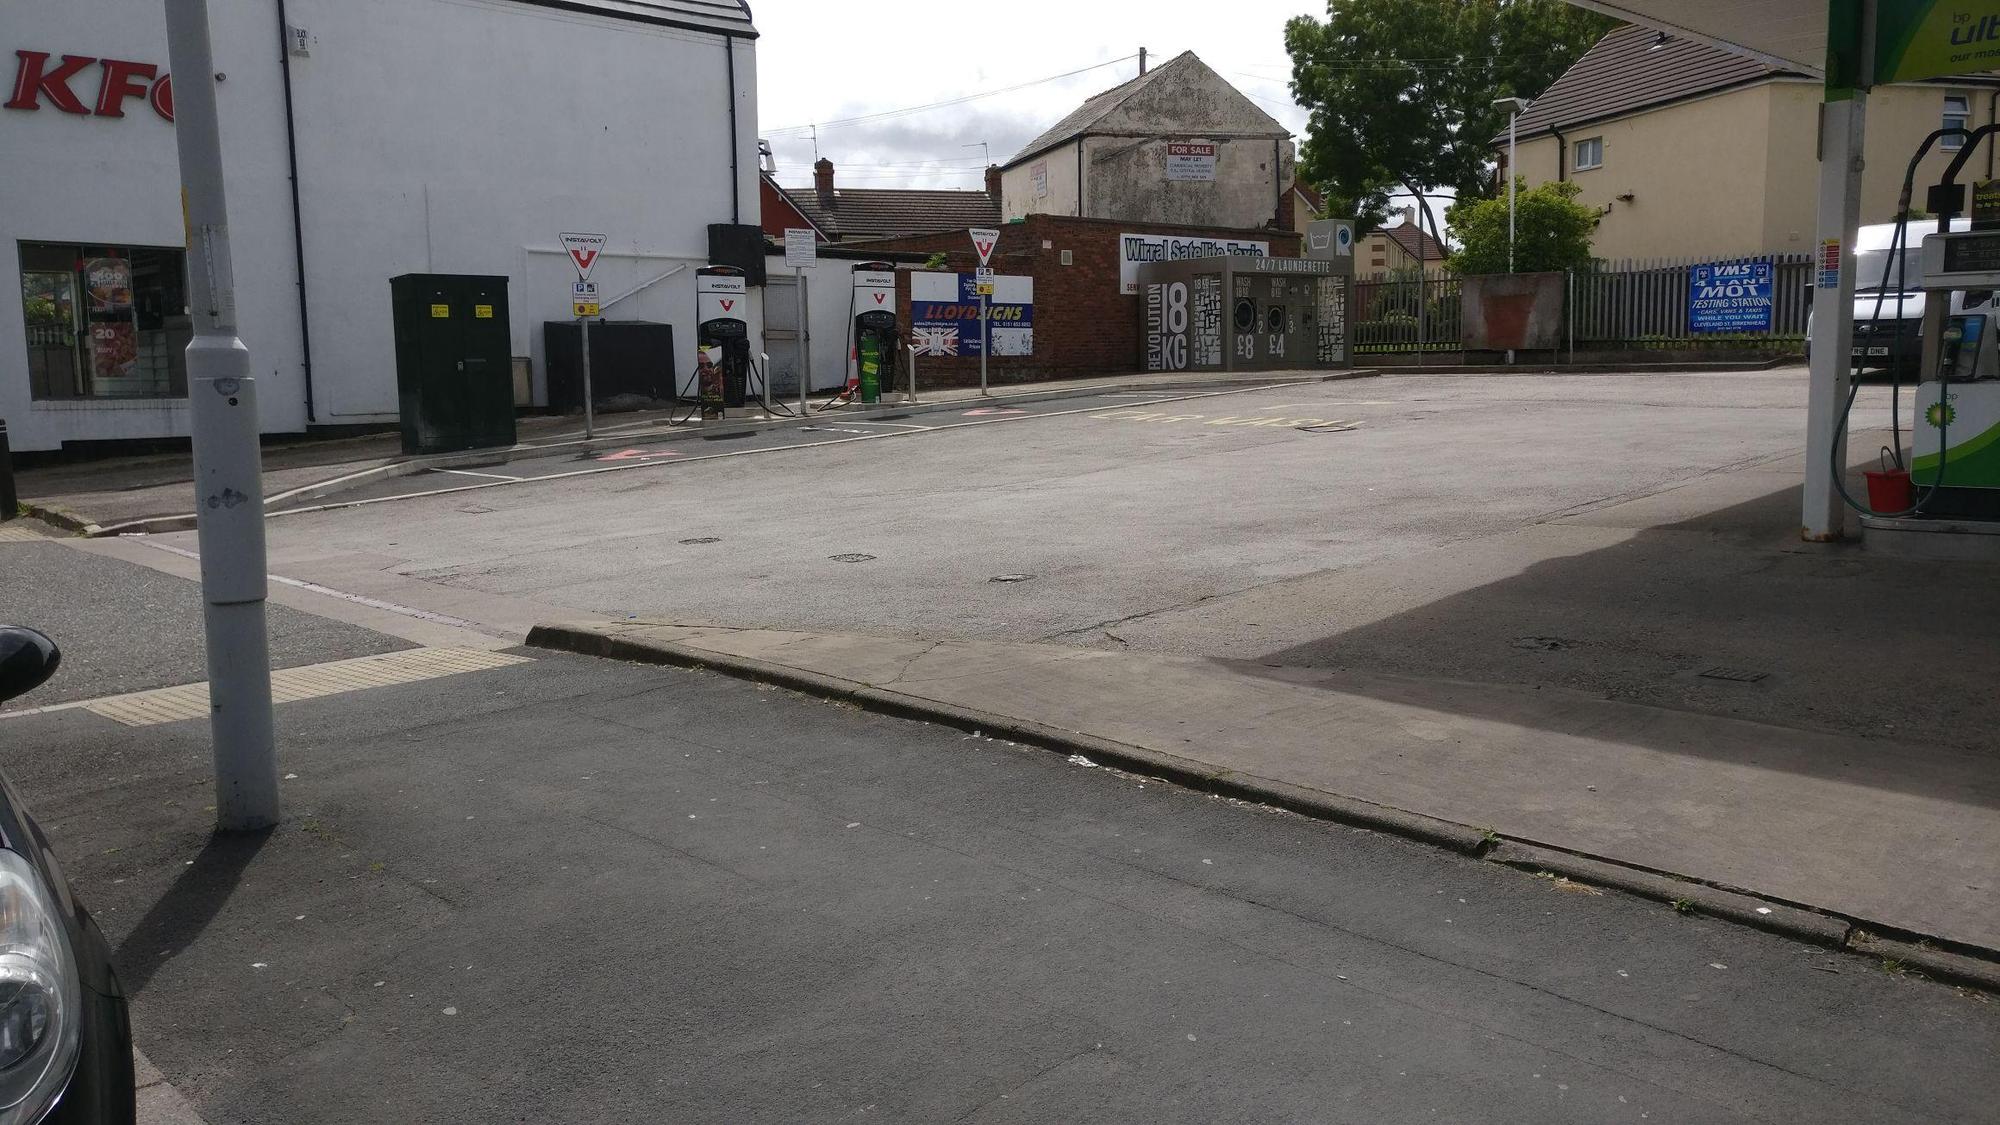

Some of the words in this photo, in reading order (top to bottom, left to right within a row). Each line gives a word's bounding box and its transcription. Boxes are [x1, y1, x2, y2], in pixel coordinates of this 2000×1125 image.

[1951, 53, 1971, 63] our
[1171, 146, 1188, 154] FOR
[1190, 146, 1211, 154] SALE
[1124, 237, 1168, 261] Wirral
[1171, 239, 1226, 260] Satellite
[1255, 259, 1276, 271] 24/7
[1278, 259, 1330, 272] LAUNDERETTE
[1714, 265, 1751, 276] VMS
[1715, 278, 1770, 286] LANE
[1699, 285, 1759, 298] MOT
[1162, 282, 1188, 333] 18
[1692, 298, 1729, 309] TESTING
[1731, 297, 1772, 308] STATION
[95, 328, 115, 339] 20
[1148, 284, 1160, 370] REVOLUTION
[1258, 320, 1263, 334] 2
[1162, 333, 1187, 370] KG
[1237, 334, 1254, 359] £8
[1269, 333, 1285, 358] £4
